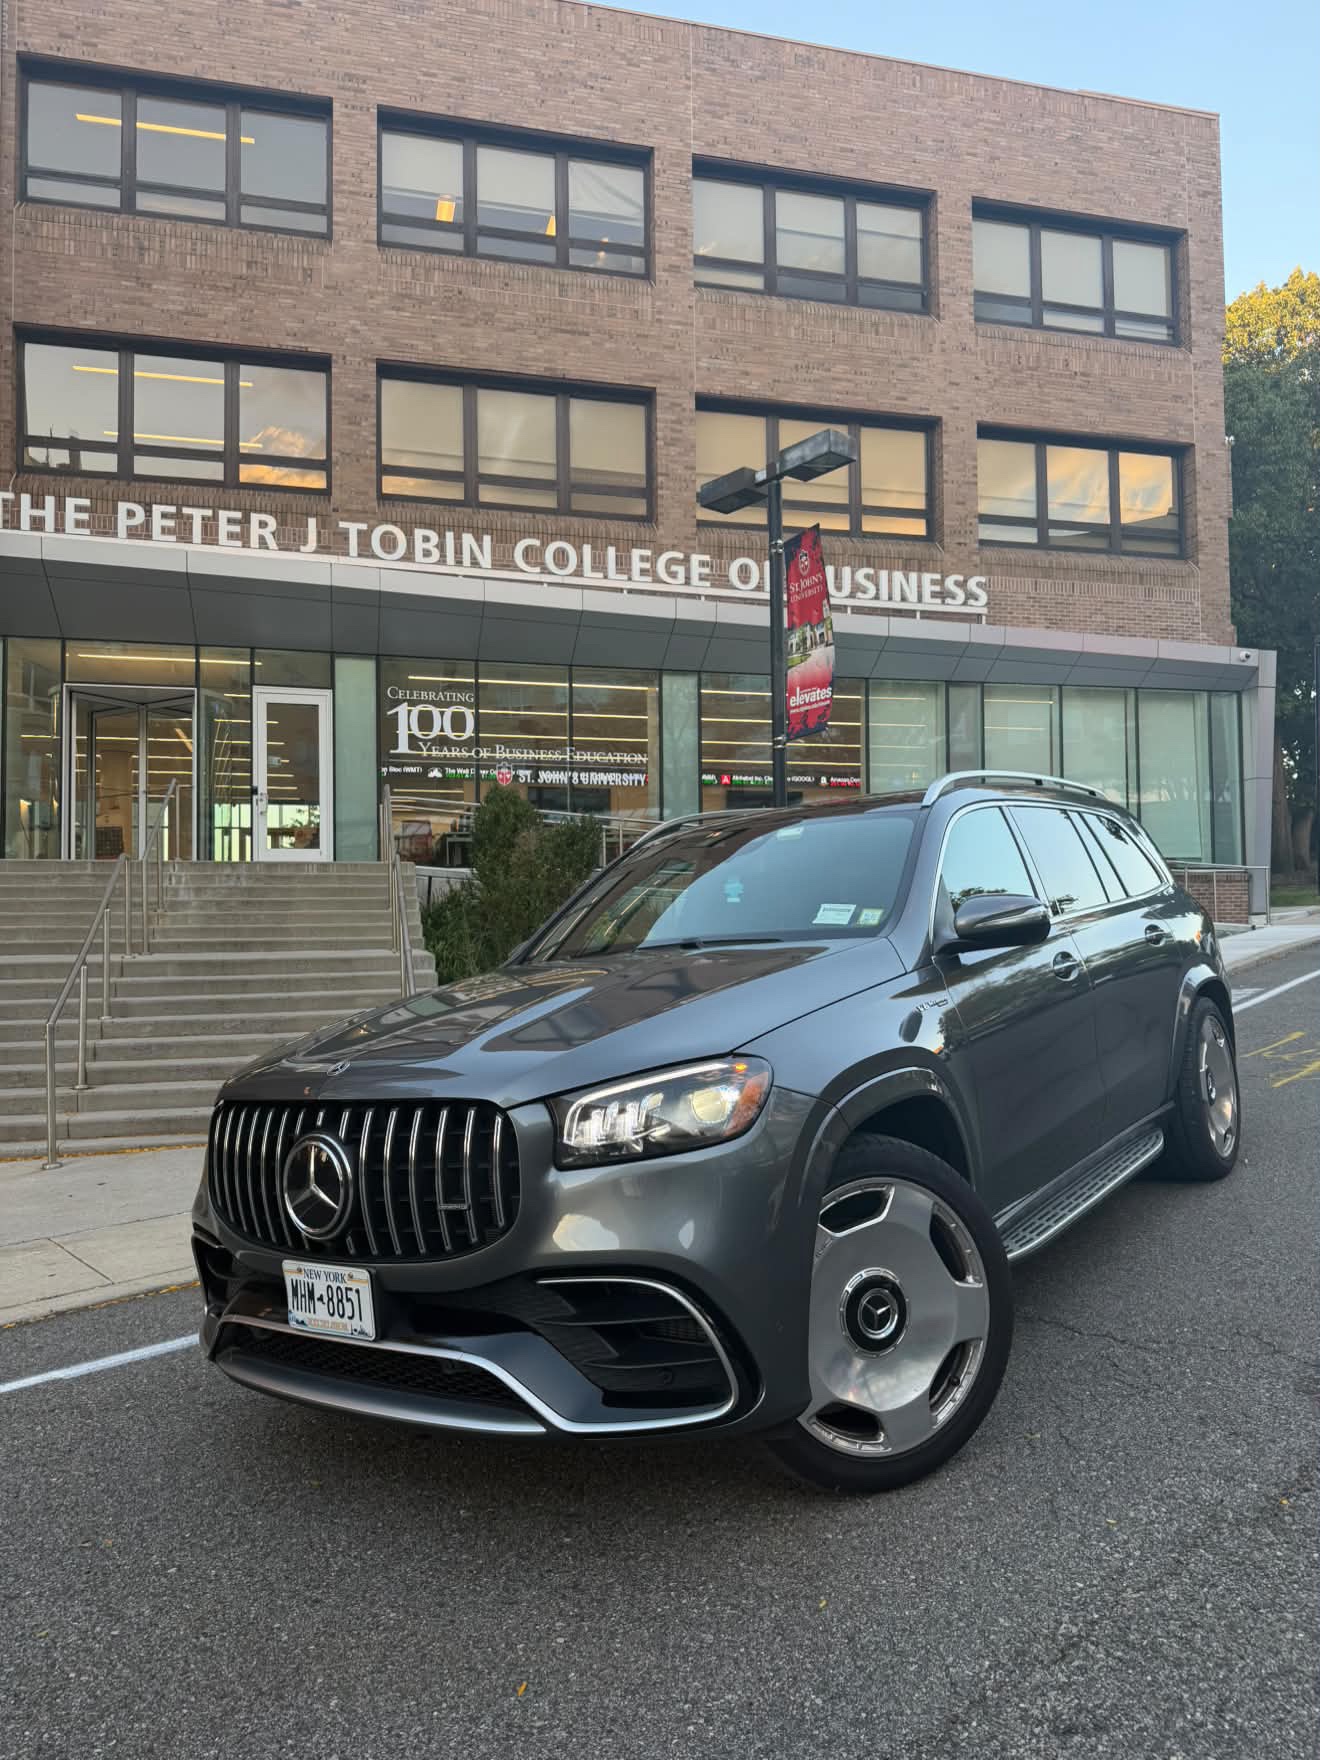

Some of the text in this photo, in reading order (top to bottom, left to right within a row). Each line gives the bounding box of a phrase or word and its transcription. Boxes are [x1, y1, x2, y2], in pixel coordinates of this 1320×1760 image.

[117, 501, 279, 551] PETER
[300, 517, 317, 553] J
[338, 521, 492, 569] TOBIN
[513, 538, 712, 588] COLLEGE
[728, 557, 770, 593] O
[825, 565, 988, 607] USINESS
[387, 686, 475, 703] CELEBRATING
[790, 686, 832, 708] elevates
[386, 702, 475, 754] 100
[418, 741, 648, 764] YEARS OF BUSINESS EDUCATION
[303, 1268, 348, 1284] NEW YORK
